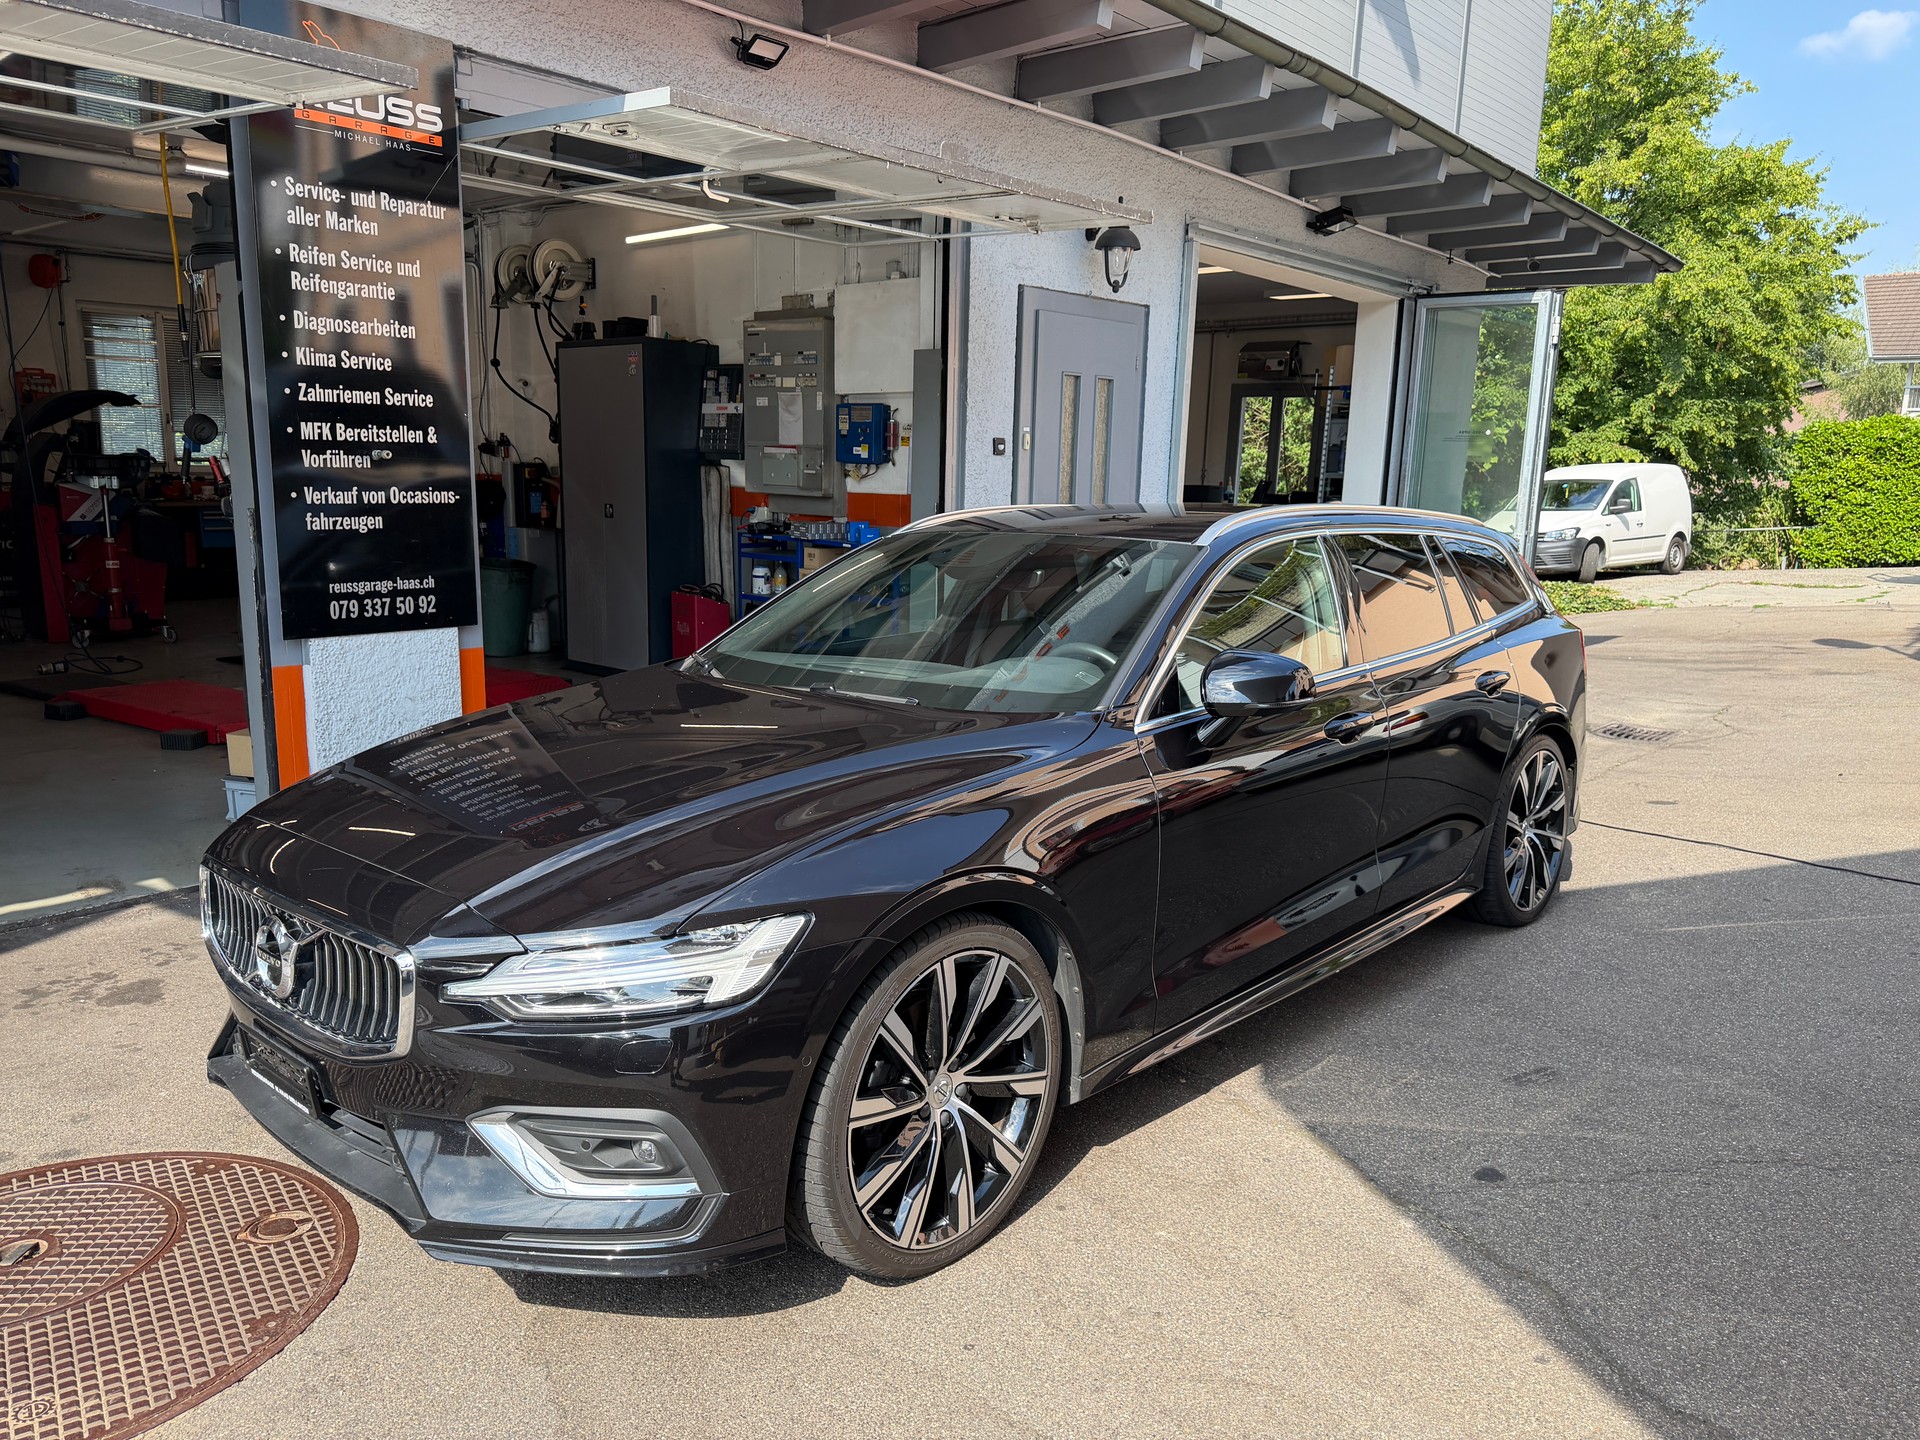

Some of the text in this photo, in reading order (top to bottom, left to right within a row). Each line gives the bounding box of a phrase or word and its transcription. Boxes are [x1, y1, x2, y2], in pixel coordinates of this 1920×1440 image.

[311, 94, 443, 133] EUSS
[301, 110, 436, 145] GARAGE
[334, 130, 411, 152] MICHAEL HAAS
[284, 176, 447, 220] Service- und Reparatur
[287, 207, 379, 236] aller Marken
[289, 243, 421, 278] Reifen Service und
[291, 271, 396, 301] Reifengarantie
[293, 310, 416, 339] Diagnosearbeiten
[296, 346, 392, 372] Klima Service
[298, 382, 434, 408] Zahnriemen Service
[300, 421, 438, 444] MFK Bereitstellen &
[301, 449, 371, 469] Vorführen
[304, 486, 460, 505] Verkauf von Occasions-
[305, 512, 383, 534] fahrzeugen
[329, 576, 435, 596] reussgarage-haas.ch
[329, 595, 436, 619] 079 337 50 92
[257, 949, 281, 968] VOLVO
